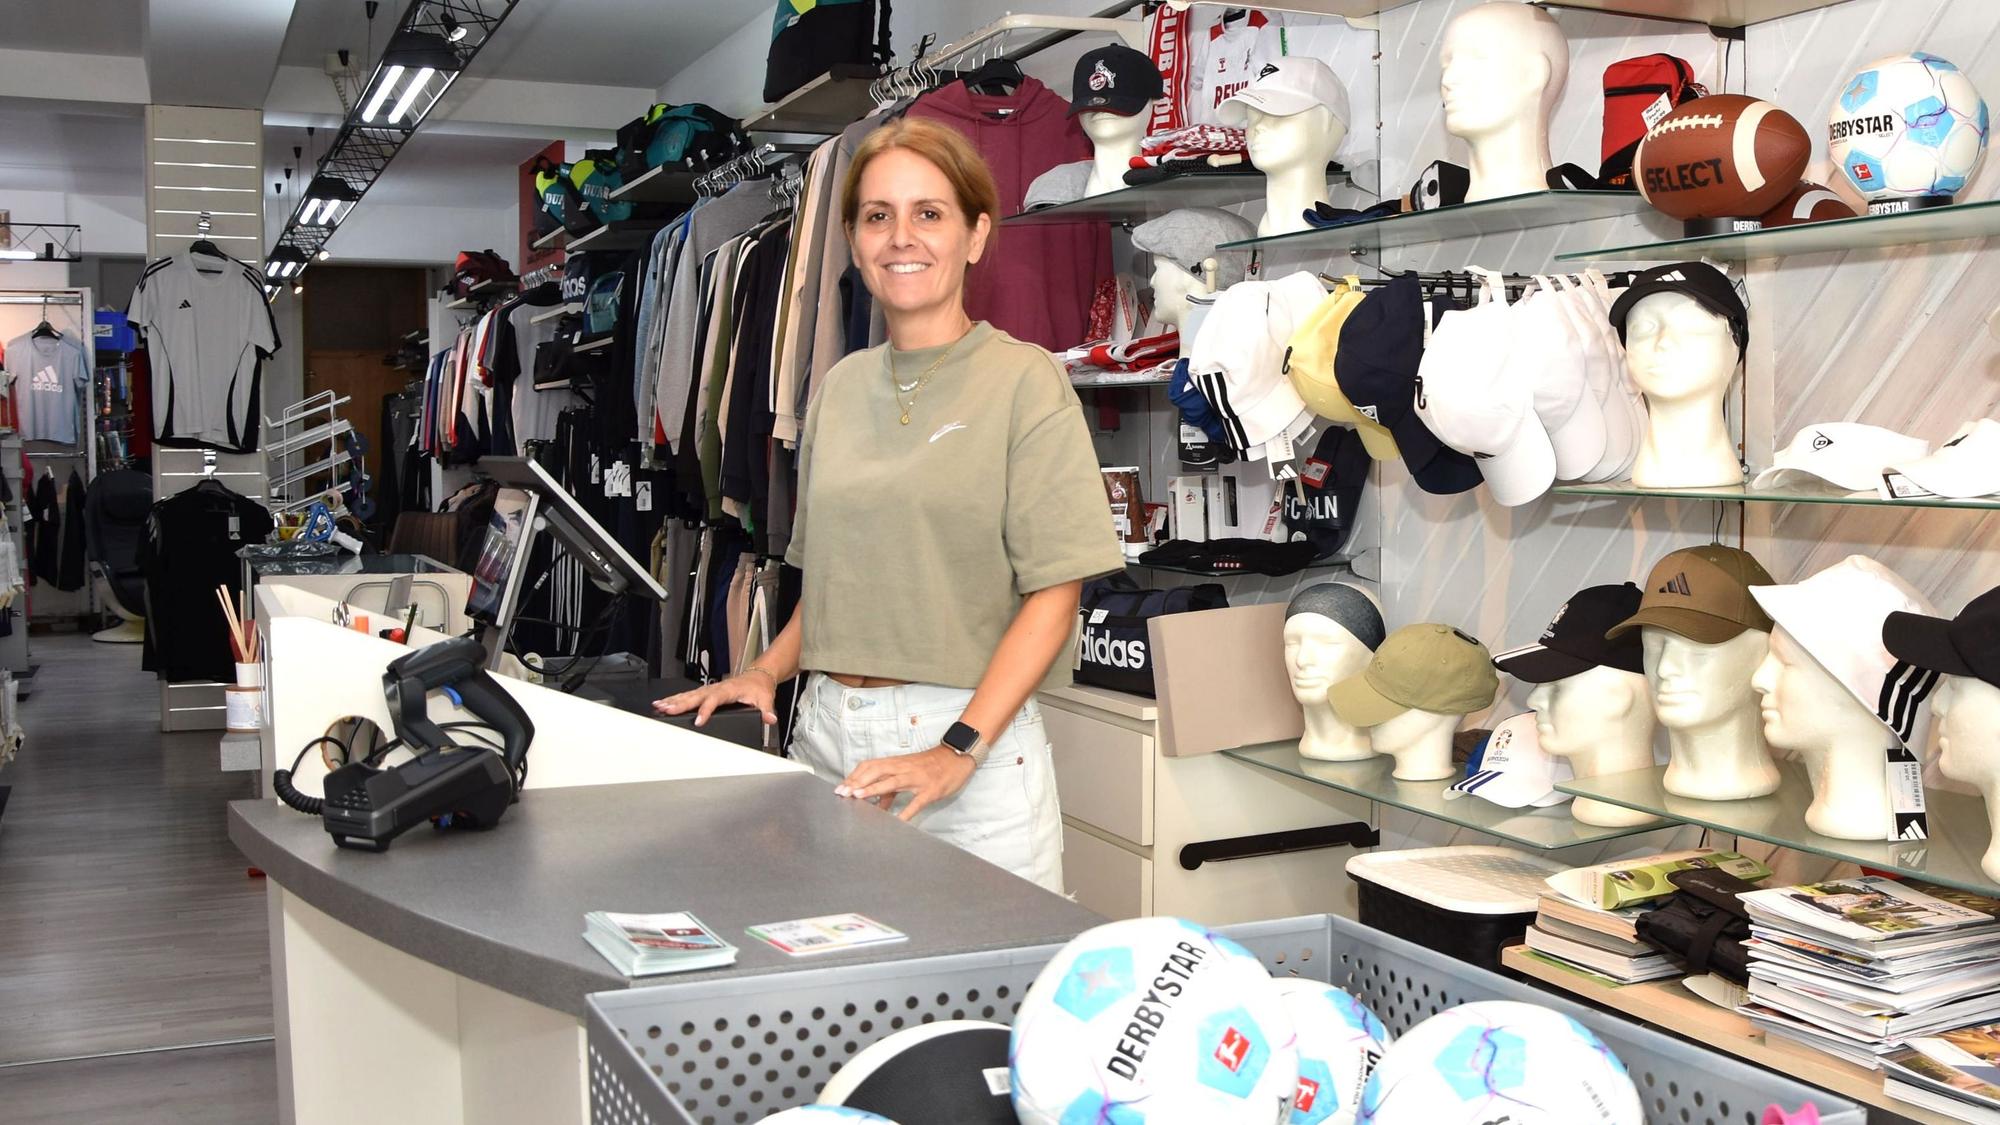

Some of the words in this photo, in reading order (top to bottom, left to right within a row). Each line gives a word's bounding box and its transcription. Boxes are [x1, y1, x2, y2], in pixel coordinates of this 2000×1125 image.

[1214, 80, 1248, 109] REW
[1829, 114, 1893, 141] DERBYSTAR
[1645, 157, 1725, 193] SELECT
[1284, 494, 1301, 520] FC
[1314, 495, 1338, 520] LN
[1081, 626, 1146, 669] didas
[1107, 941, 1207, 1081] DERBYSTAR
